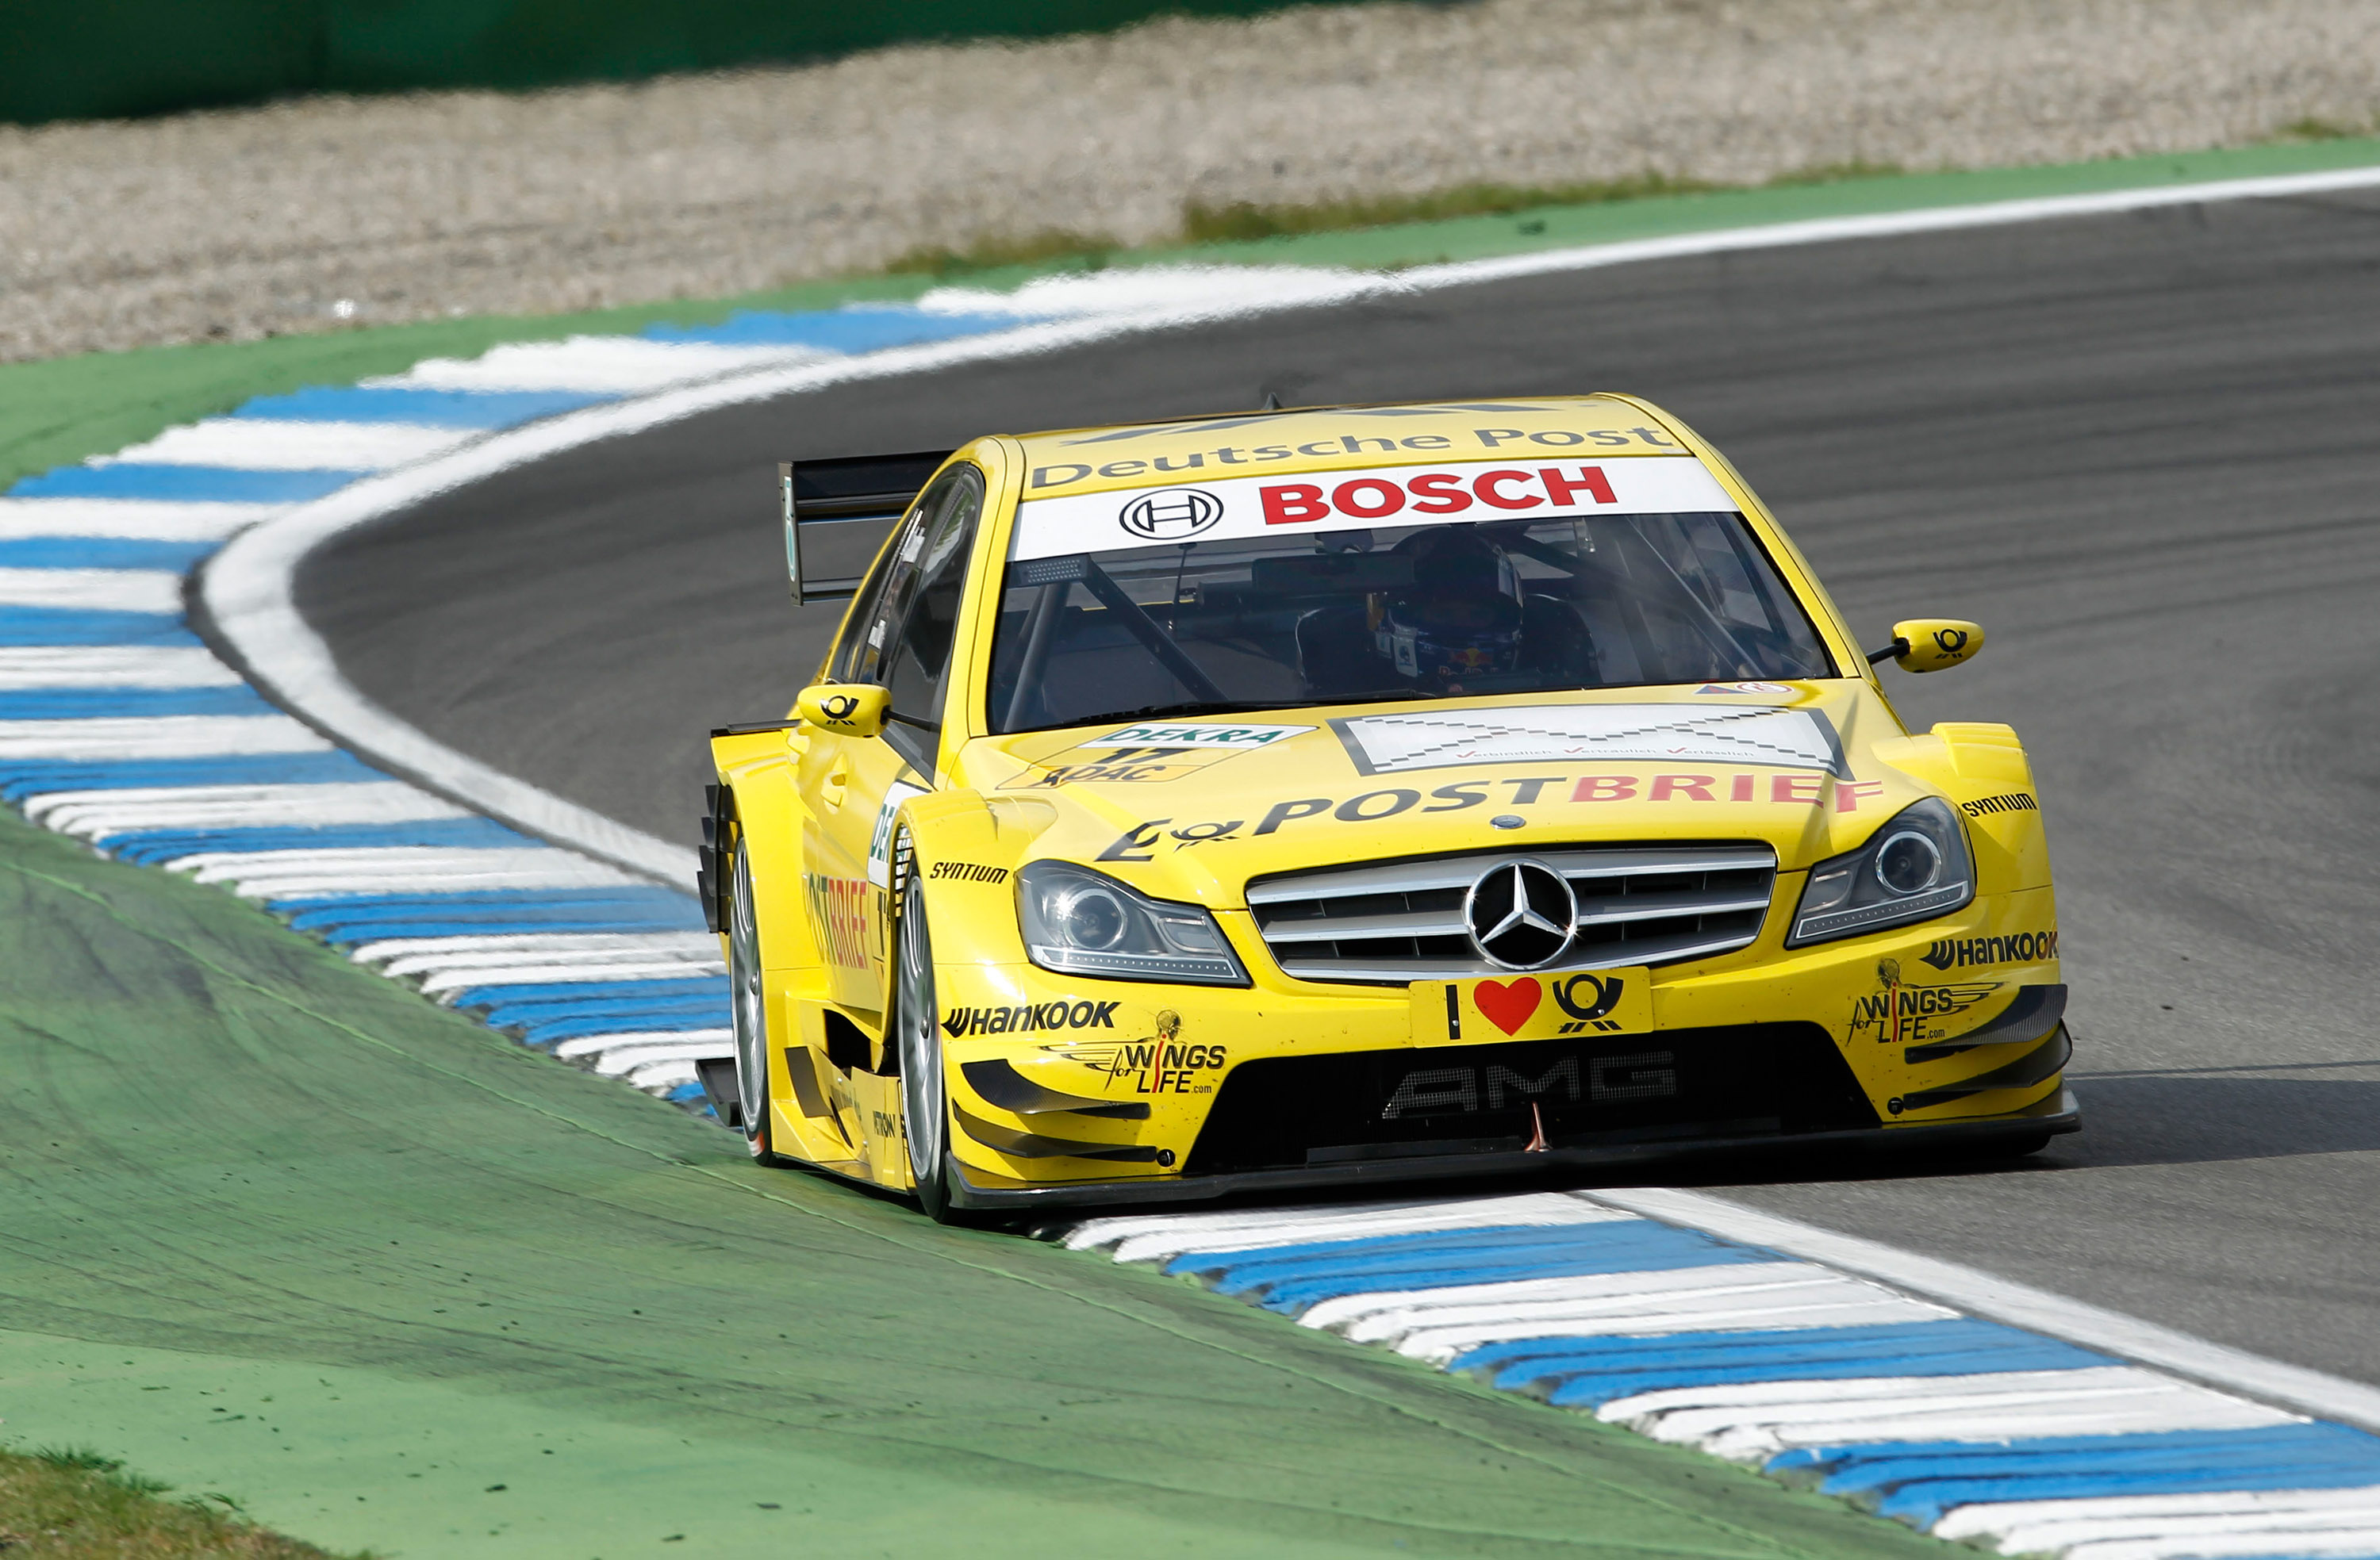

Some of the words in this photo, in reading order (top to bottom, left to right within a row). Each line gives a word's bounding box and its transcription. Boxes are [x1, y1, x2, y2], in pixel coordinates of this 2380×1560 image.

[1031, 435, 1451, 489] Deutsche
[1480, 427, 1676, 448] Post
[1259, 466, 1618, 525] BOSCH
[1098, 726, 1285, 743] DEKRA
[1031, 765, 1167, 787] ADAC
[1092, 748, 1200, 765] 17
[1253, 775, 1883, 836] POSTBRIEF
[1962, 793, 2038, 818] SYNTIUM
[930, 862, 1008, 884] SYNTIUM
[1445, 984, 1461, 1040] I
[1381, 1051, 1676, 1119] AMG
